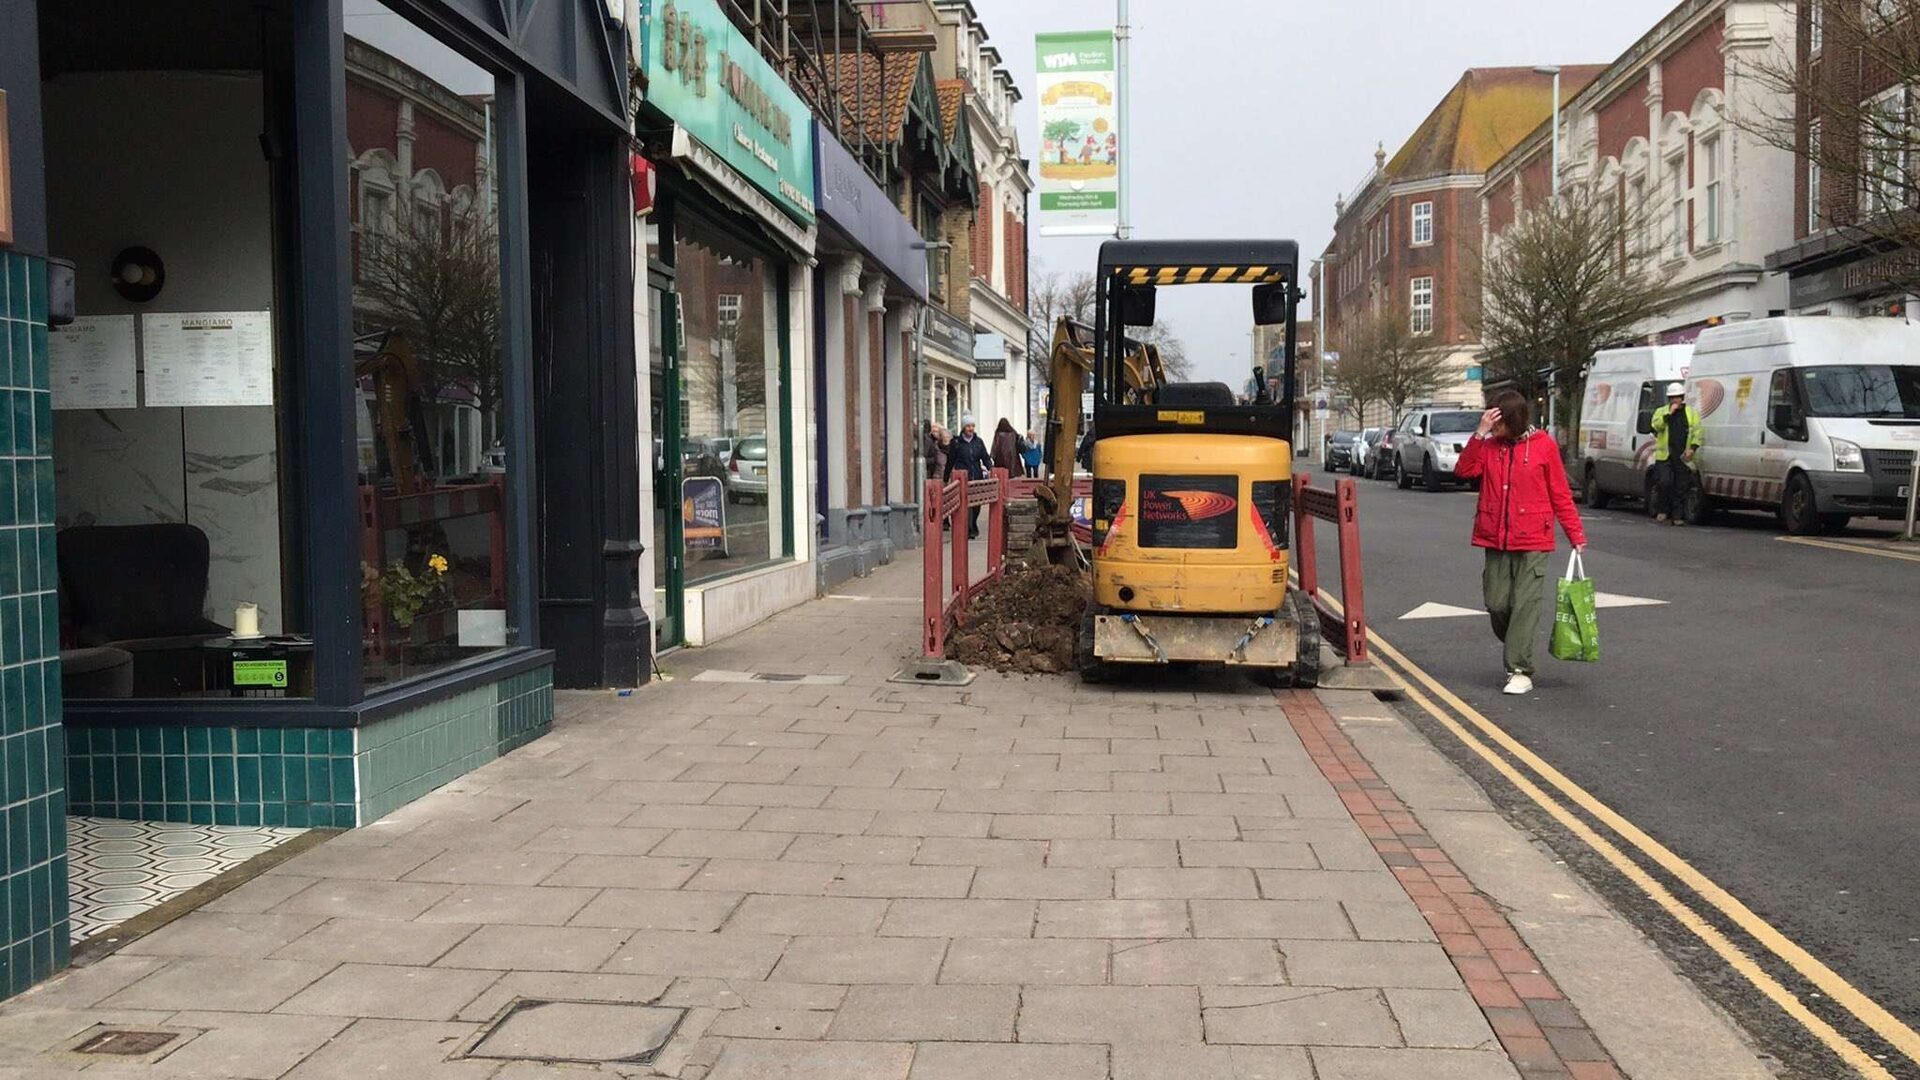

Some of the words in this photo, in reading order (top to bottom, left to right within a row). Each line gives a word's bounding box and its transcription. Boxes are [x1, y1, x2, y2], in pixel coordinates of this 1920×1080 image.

[1043, 53, 1077, 68] WTM
[181, 318, 233, 326] MANGIAMO
[1143, 490, 1156, 499] UK
[1143, 501, 1172, 509] Power
[1143, 511, 1187, 520] Networks
